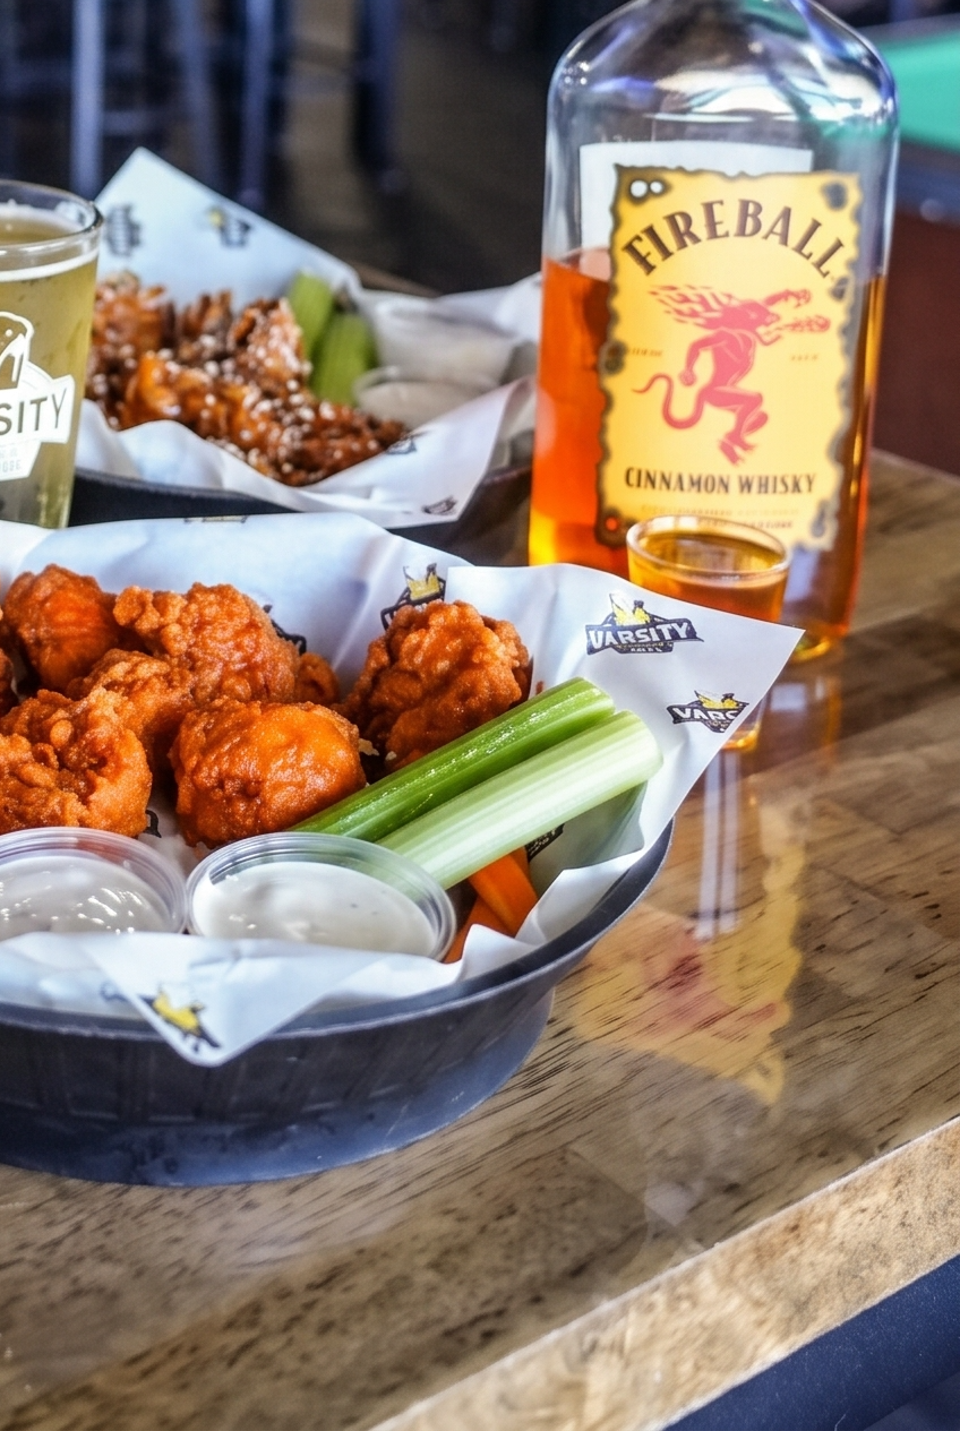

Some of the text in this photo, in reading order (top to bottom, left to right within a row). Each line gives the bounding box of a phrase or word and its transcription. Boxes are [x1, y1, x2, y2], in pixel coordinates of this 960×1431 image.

[621, 198, 844, 279] FIREBALL
[625, 467, 817, 495] CINNAMON WHISKY
[588, 622, 689, 650] VARSITY
